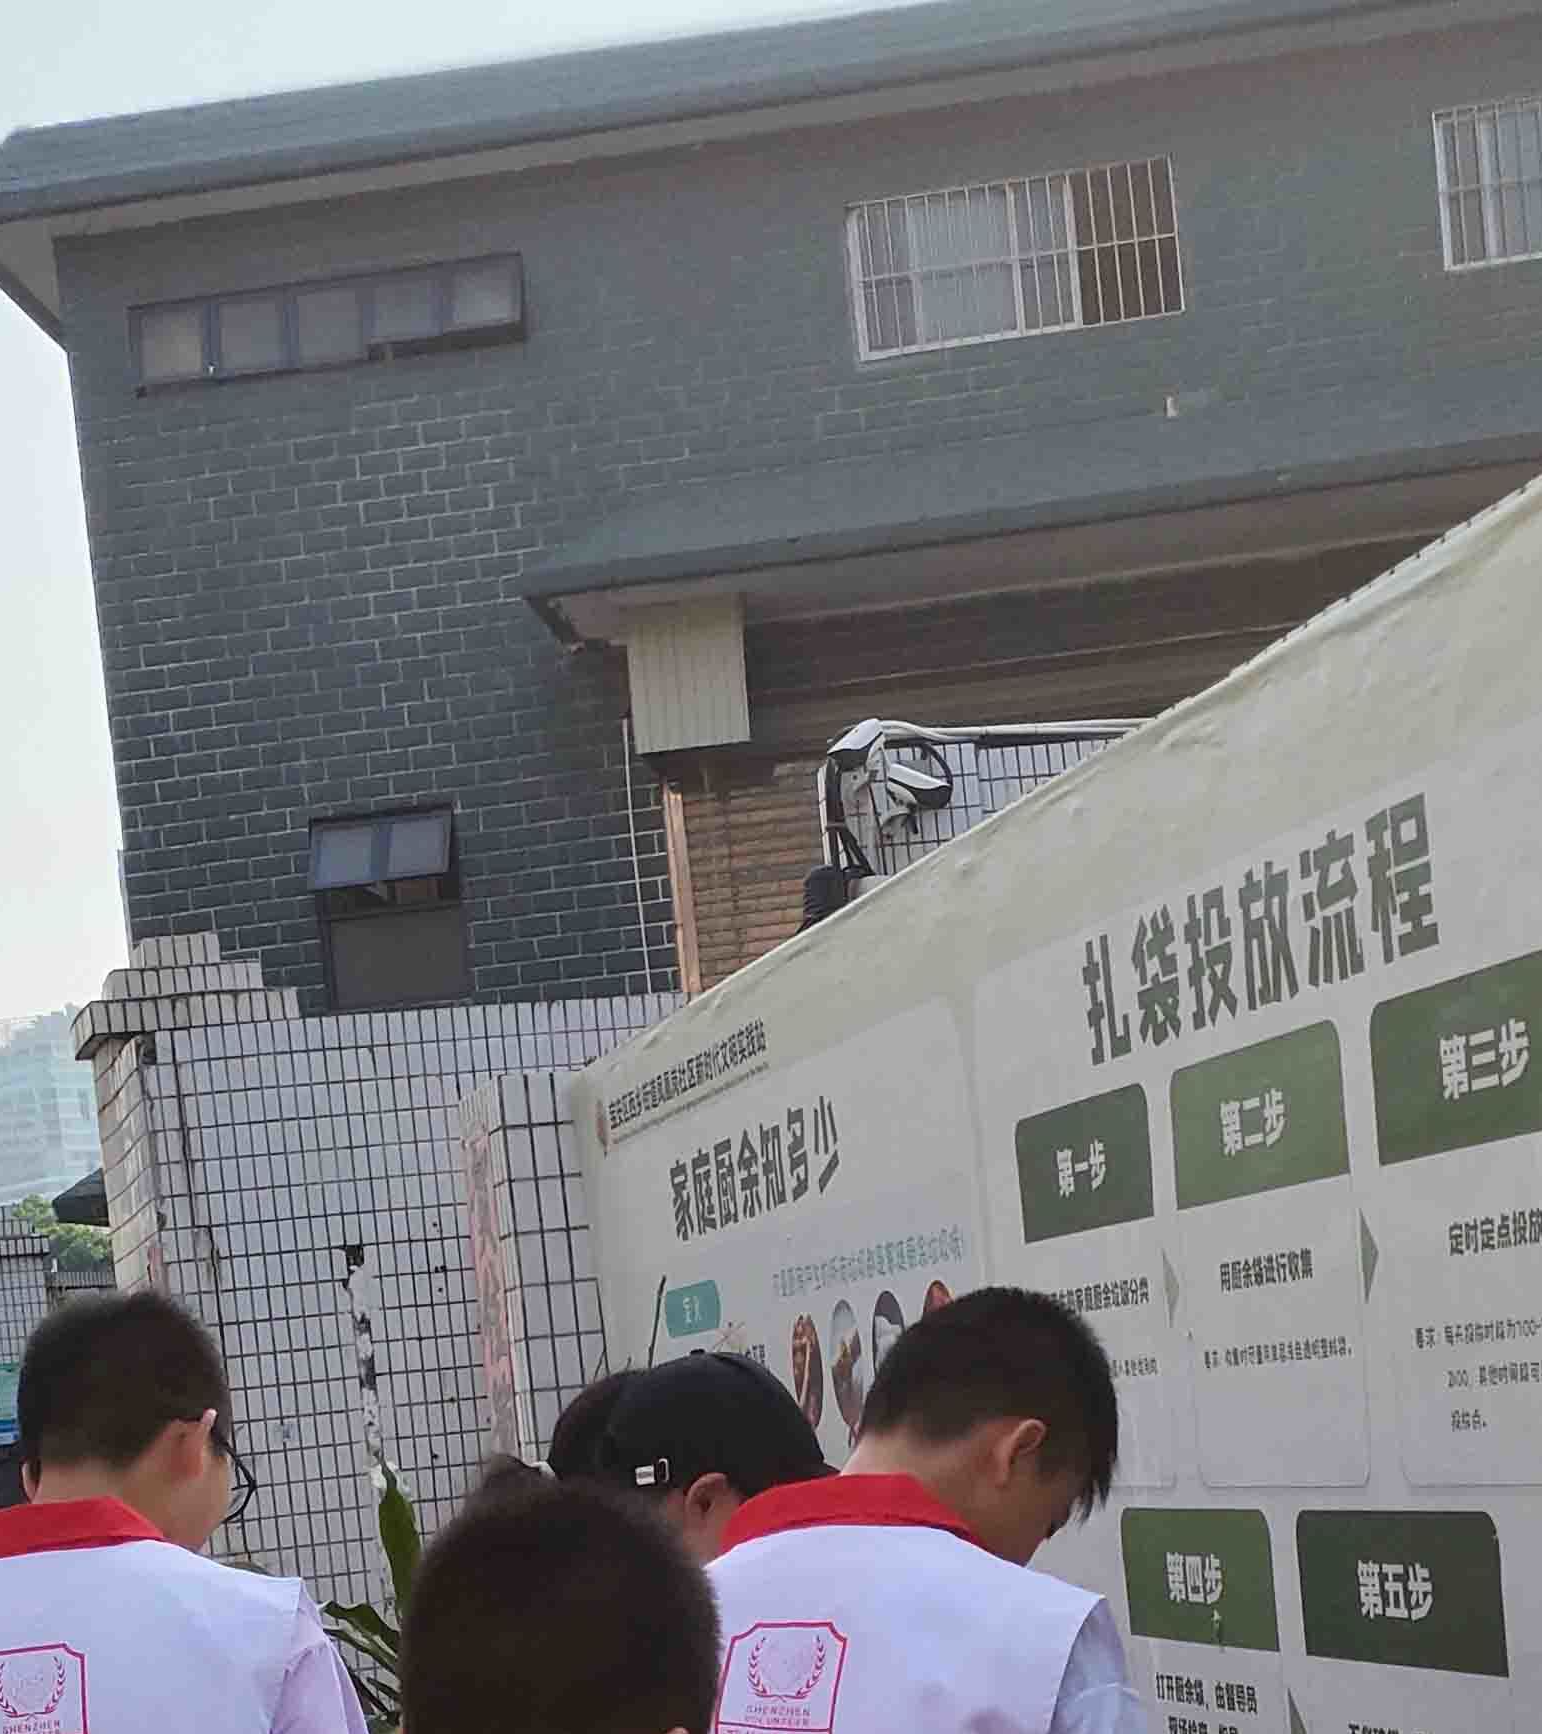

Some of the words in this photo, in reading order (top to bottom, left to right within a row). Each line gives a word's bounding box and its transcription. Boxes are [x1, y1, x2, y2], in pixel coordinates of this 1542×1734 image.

[1081, 791, 1440, 1067] 扎袋投放流程
[1439, 1018, 1531, 1101] 第三步
[1219, 1086, 1286, 1158] 第二步
[669, 1095, 841, 1241] 家庭厨余知多少
[1056, 1139, 1107, 1199] 第一步
[1219, 1247, 1313, 1293] 用厨余袋进行收集
[1165, 1550, 1224, 1607] 第四步
[1357, 1558, 1435, 1623] 第五步
[1156, 1672, 1259, 1716] 打开厨余袋，由督导员
